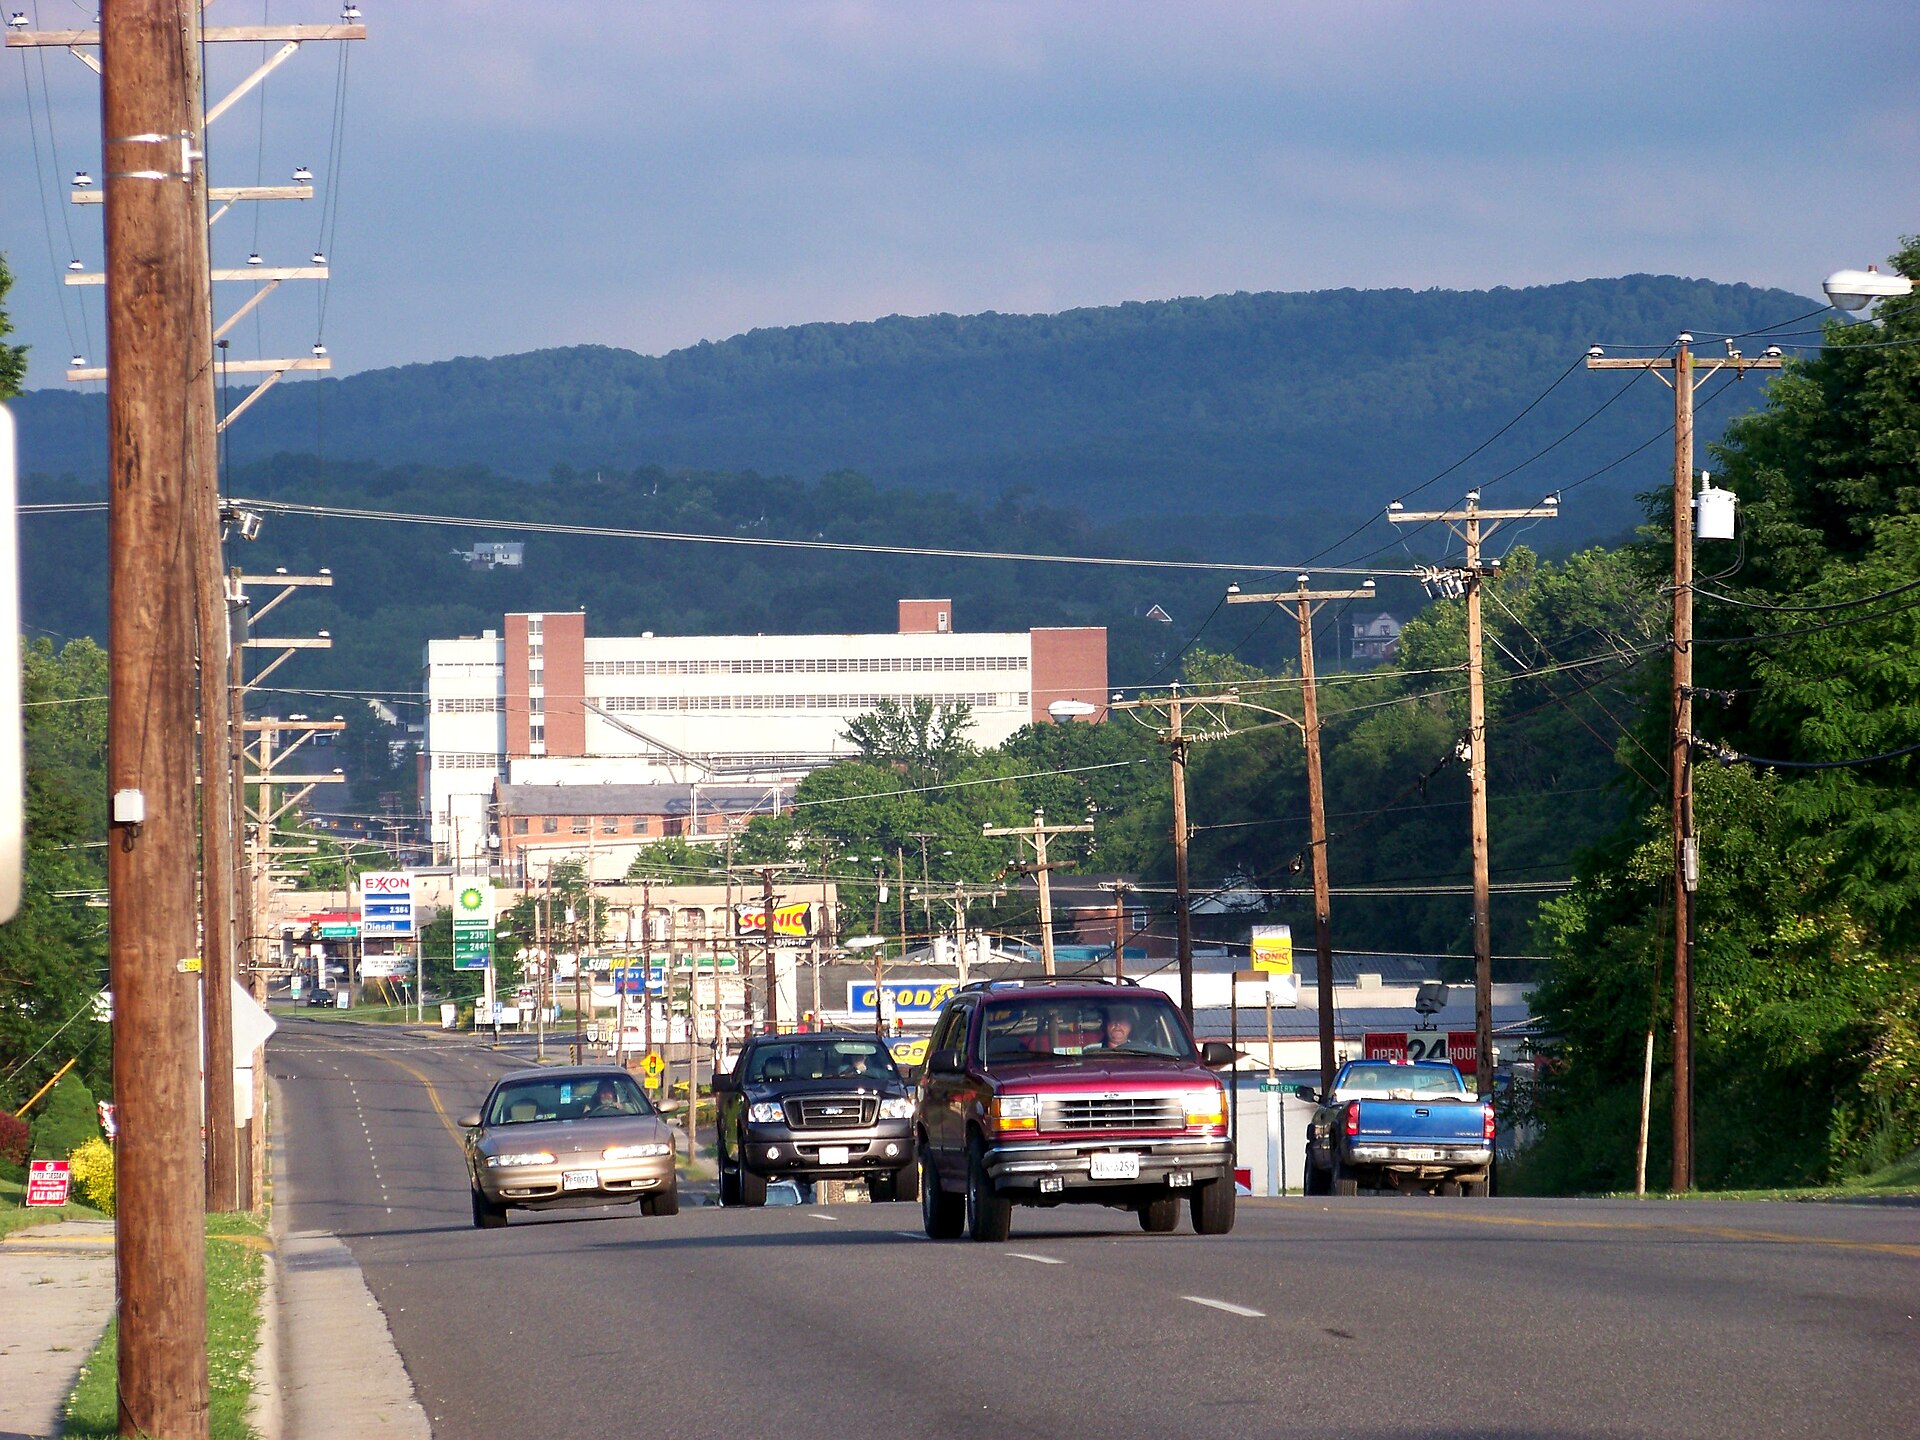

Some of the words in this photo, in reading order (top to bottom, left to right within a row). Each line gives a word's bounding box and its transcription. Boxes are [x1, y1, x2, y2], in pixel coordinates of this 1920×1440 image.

[365, 877, 409, 893] EXXON
[743, 912, 804, 928] SONIC
[1259, 952, 1288, 960] SONIC
[1372, 1048, 1403, 1060] OPEN
[1408, 1038, 1447, 1060] 24
[1260, 1085, 1294, 1093] NEWBERN
[32, 1191, 46, 1201] ALL
